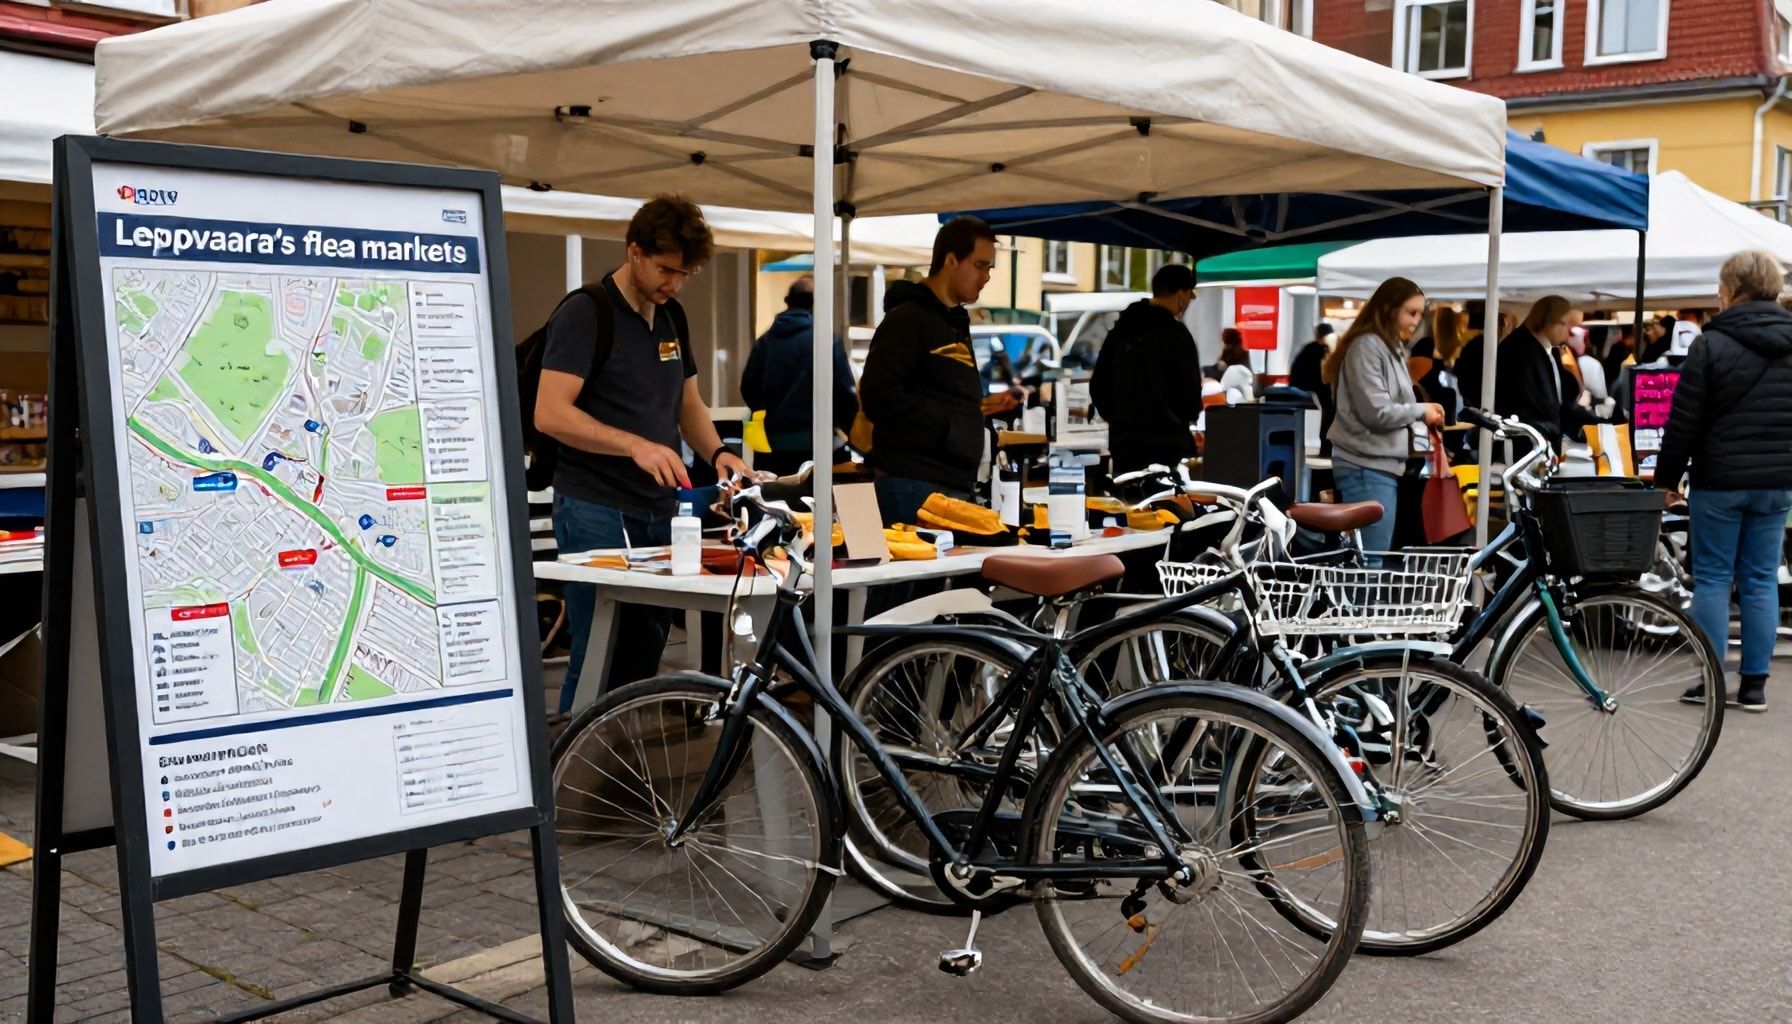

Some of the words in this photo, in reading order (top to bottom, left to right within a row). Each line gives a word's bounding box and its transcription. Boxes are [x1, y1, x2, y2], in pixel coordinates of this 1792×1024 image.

[116, 218, 296, 257] Leppvaara's
[303, 230, 356, 259] flea
[362, 235, 467, 264] markets
